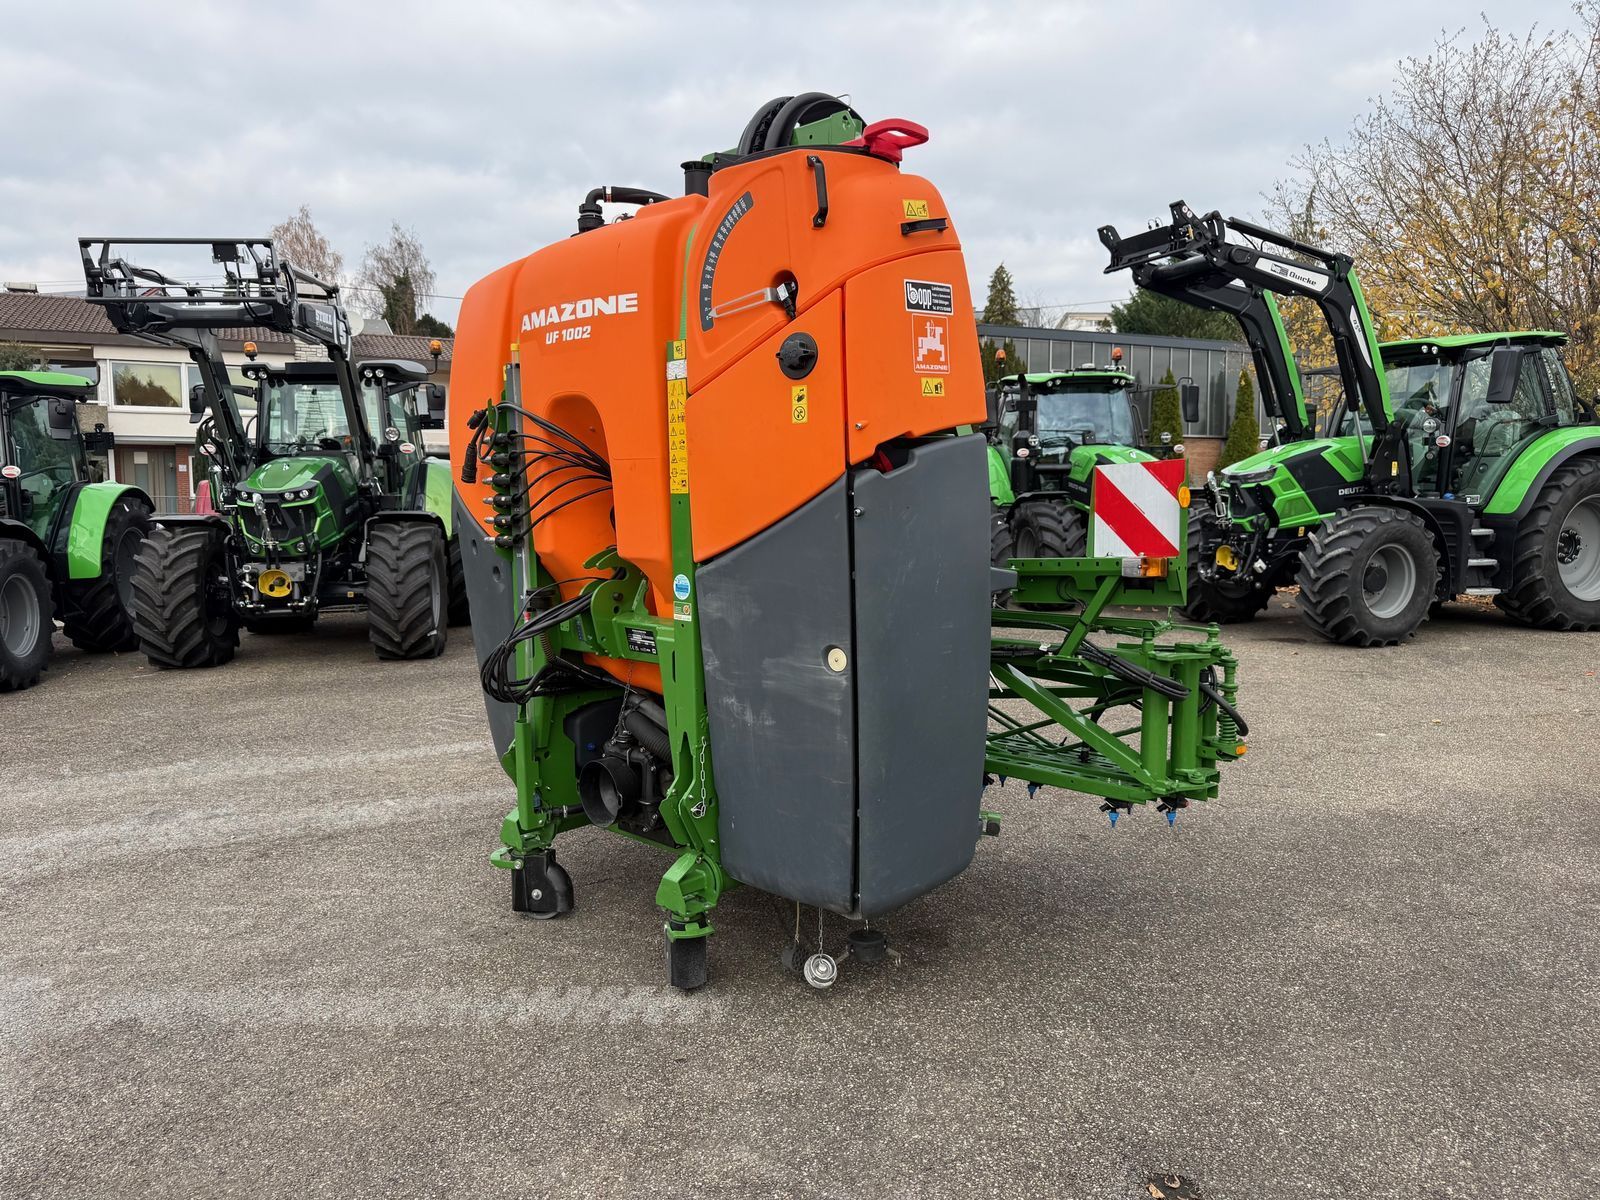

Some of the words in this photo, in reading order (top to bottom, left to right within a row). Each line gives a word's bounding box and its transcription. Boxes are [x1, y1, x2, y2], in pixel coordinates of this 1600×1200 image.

[1289, 271, 1317, 286] Quicke
[521, 293, 638, 333] AMAZONE
[545, 331, 559, 345] UF
[561, 325, 591, 342] 1002
